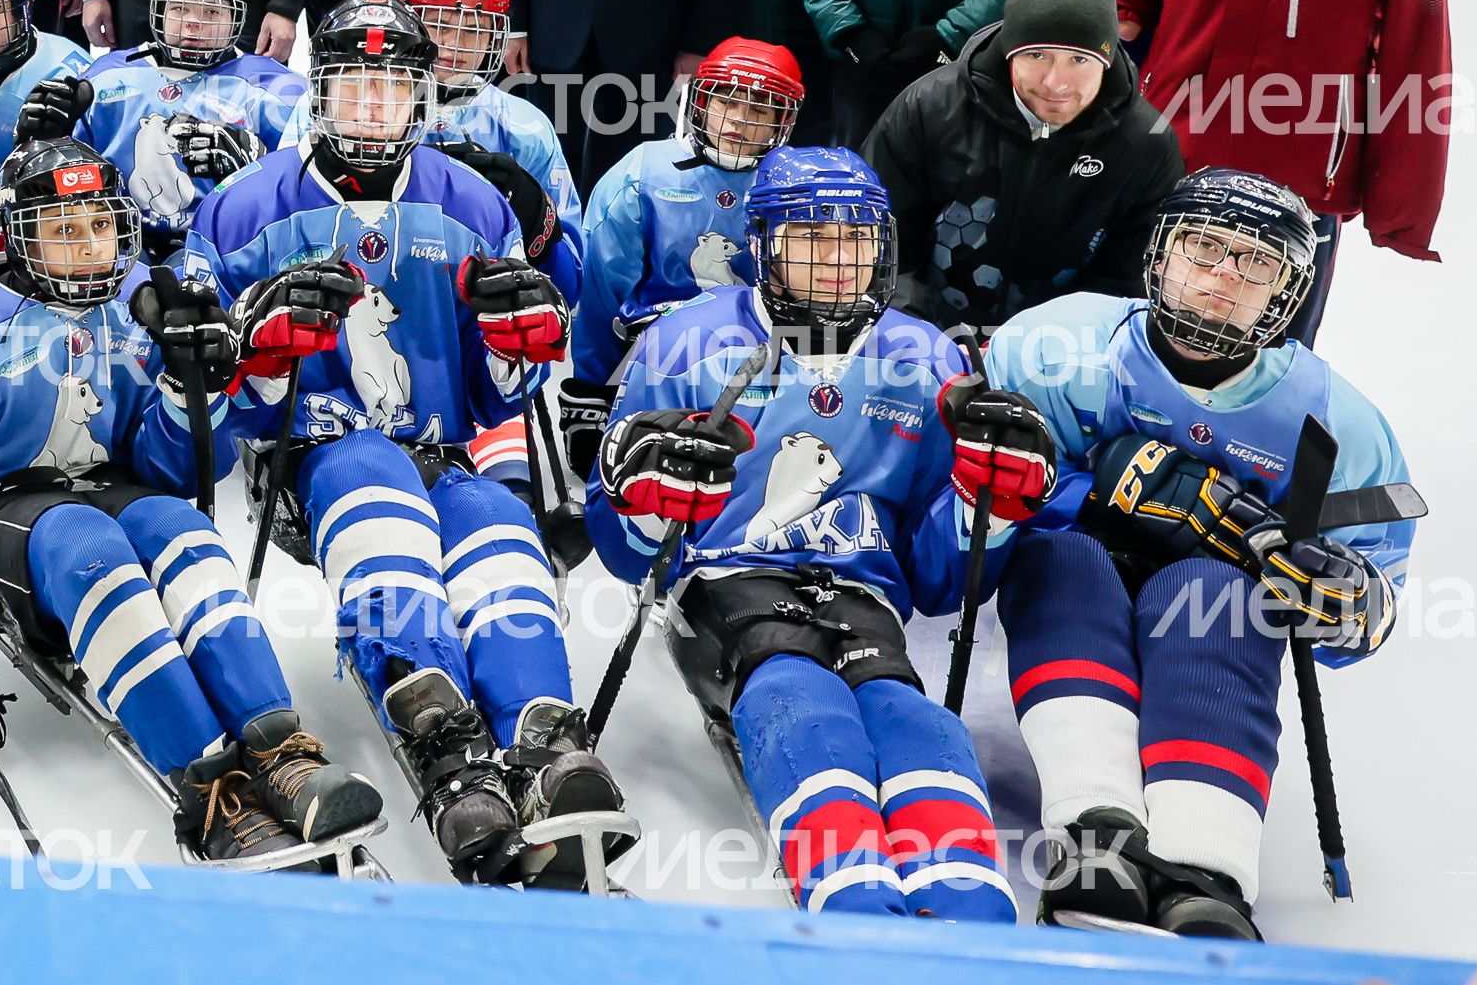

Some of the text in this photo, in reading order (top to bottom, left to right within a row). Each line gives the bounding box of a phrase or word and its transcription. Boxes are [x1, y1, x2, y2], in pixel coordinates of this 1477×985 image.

[357, 41, 395, 50] CM
[730, 68, 766, 82] BAUER
[815, 188, 863, 198] BAUER
[1229, 195, 1282, 218] BAUER
[833, 646, 880, 674] UER
